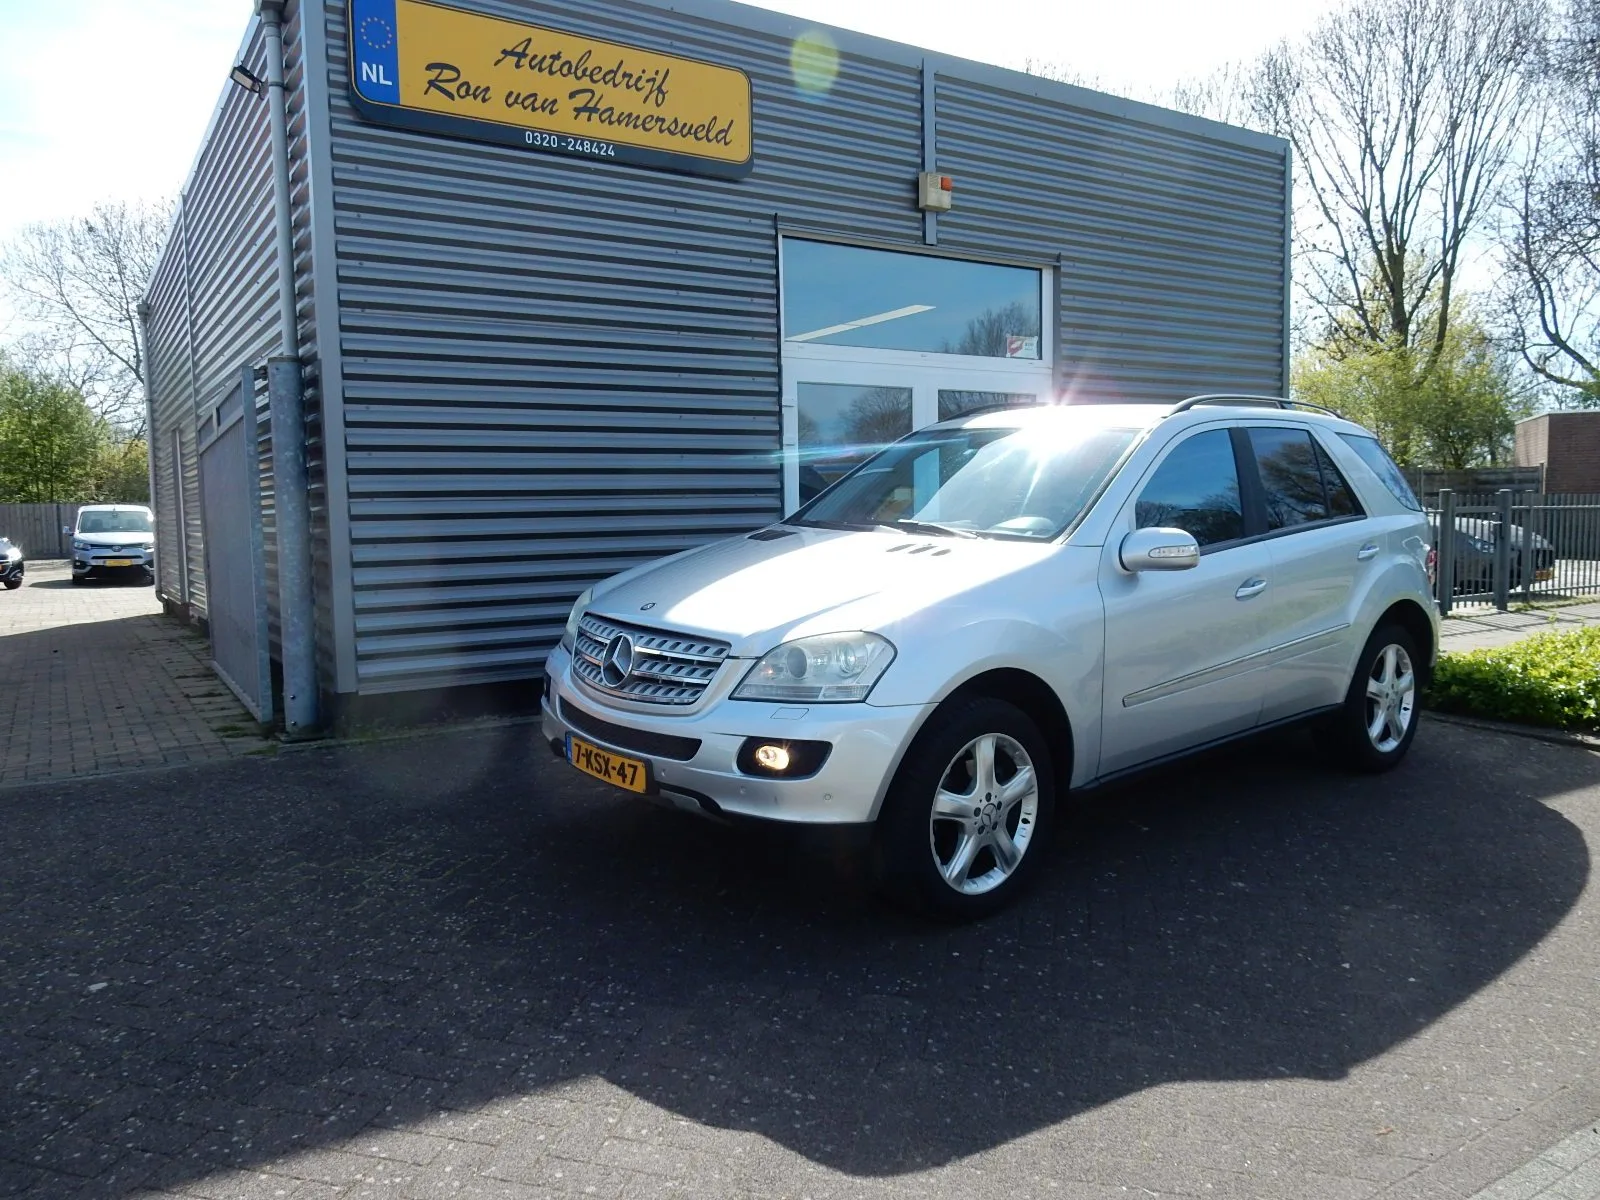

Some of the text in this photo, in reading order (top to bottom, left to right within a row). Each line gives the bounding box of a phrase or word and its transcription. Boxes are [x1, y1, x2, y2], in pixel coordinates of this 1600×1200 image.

[361, 62, 393, 86] NL
[494, 38, 670, 105] Autobedrijf
[423, 62, 733, 147] Ron van Hamersveld
[574, 743, 638, 786] 7-KSX-47
